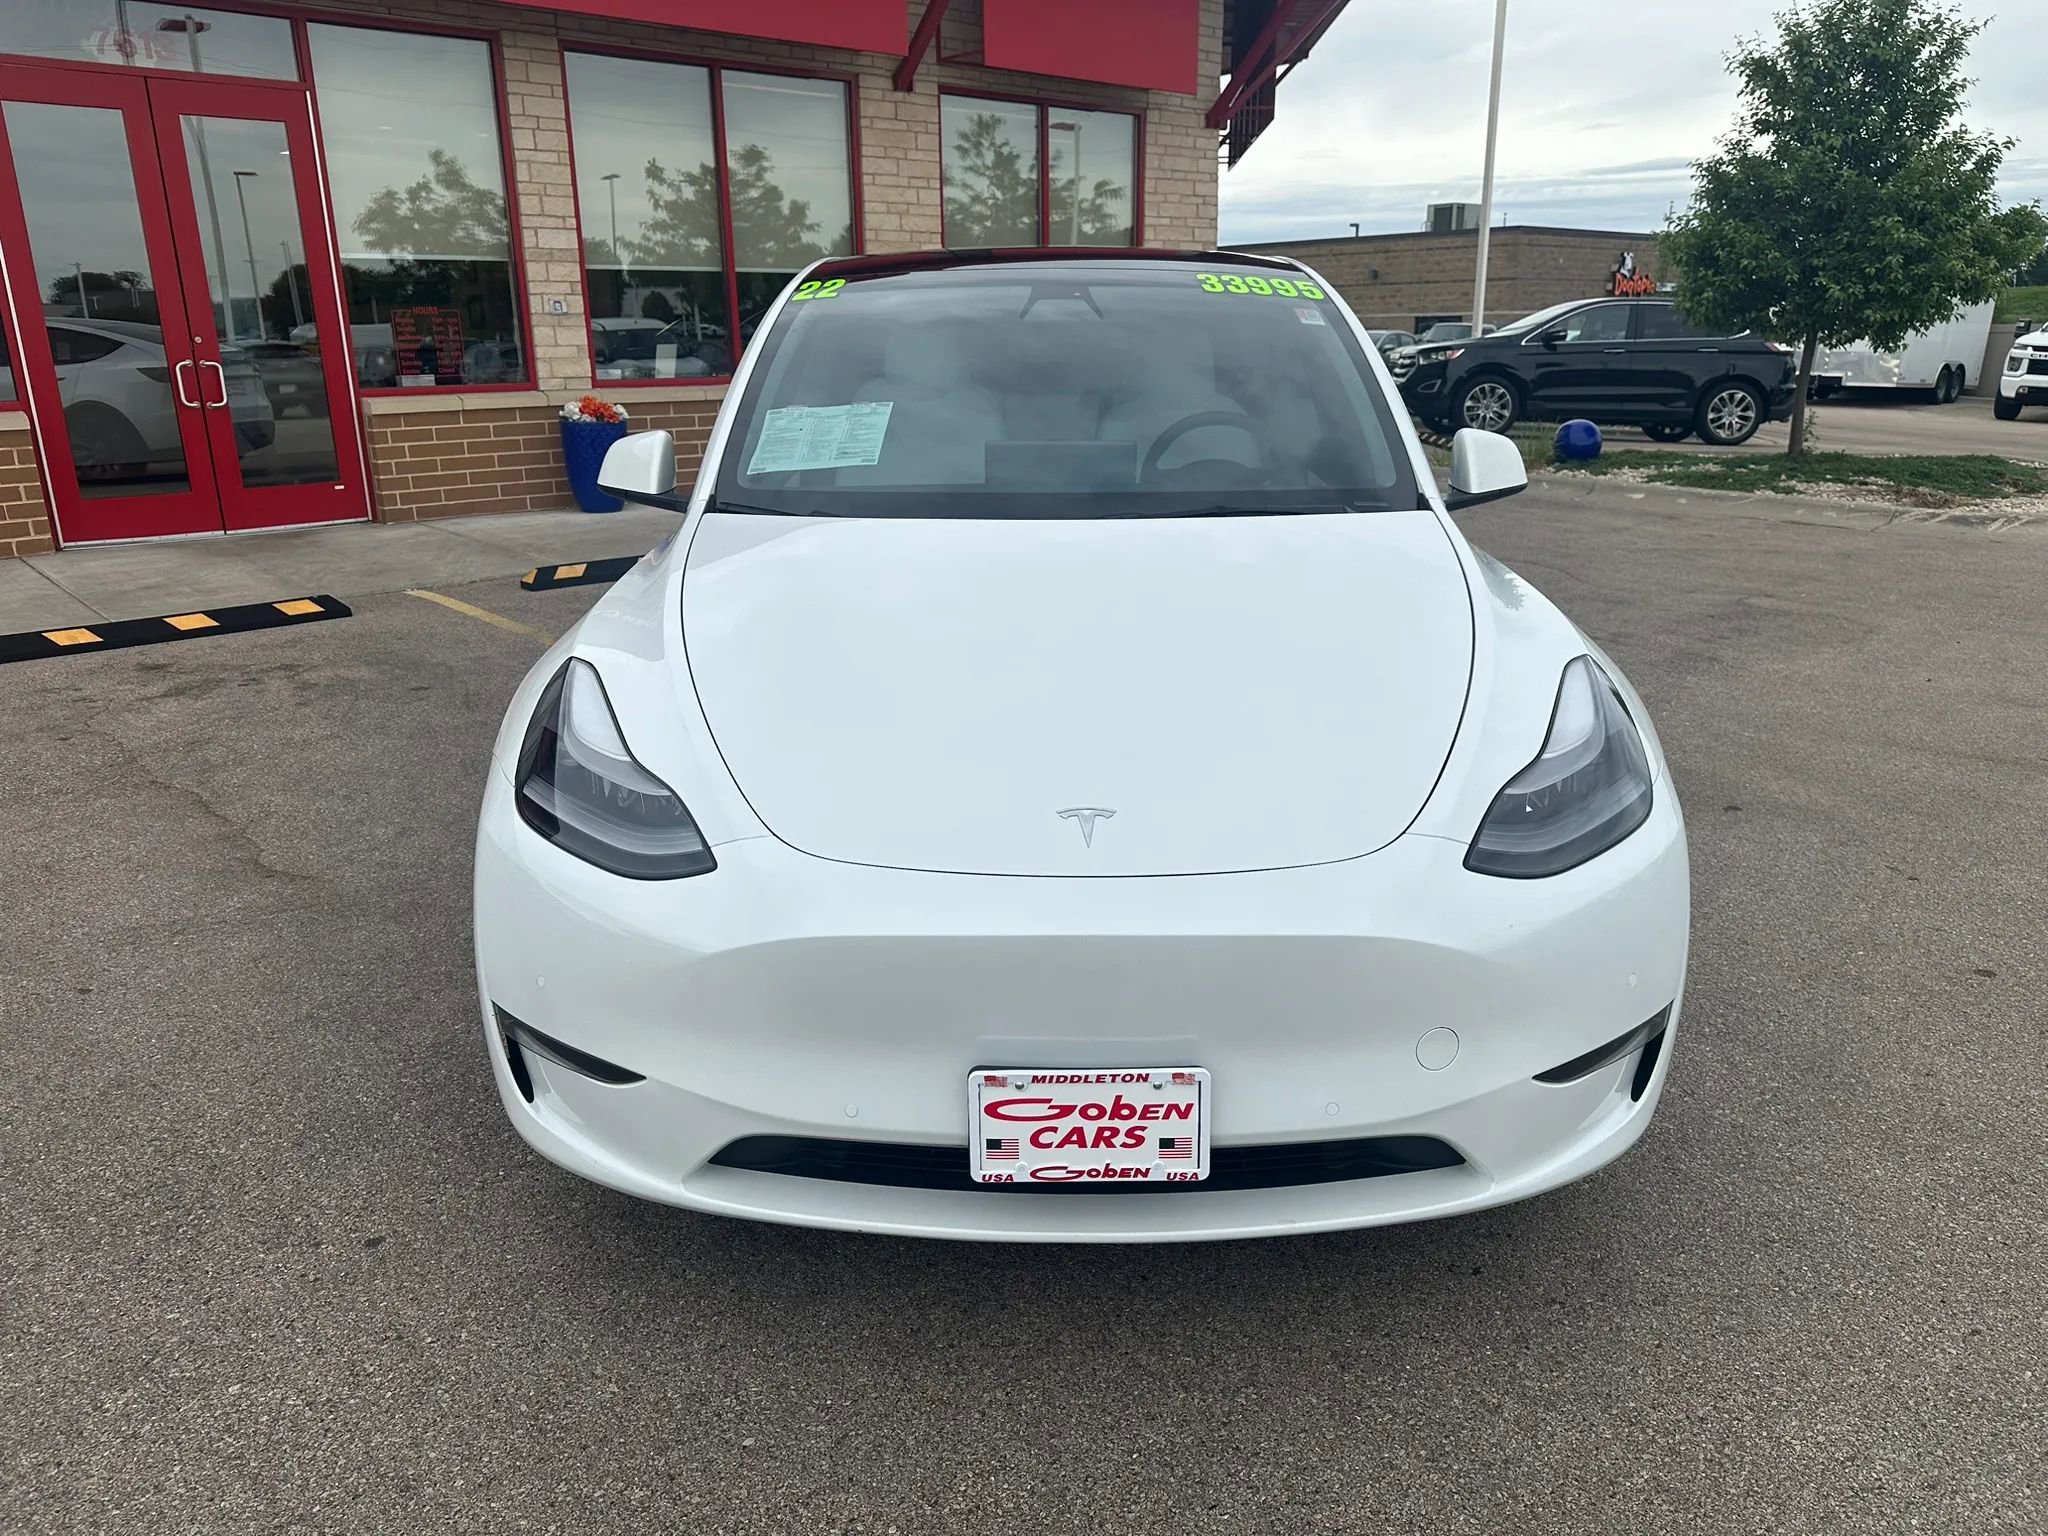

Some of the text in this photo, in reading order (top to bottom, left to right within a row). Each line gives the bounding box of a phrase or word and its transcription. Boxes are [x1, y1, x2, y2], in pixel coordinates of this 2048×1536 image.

[791, 279, 846, 301] 22
[1196, 273, 1325, 300] 33995
[412, 306, 439, 315] HOURS
[1031, 1073, 1149, 1084] MIDDLETON
[1029, 1125, 1149, 1149] CARS
[981, 1173, 1015, 1183] USA
[1166, 1171, 1200, 1181] USA
